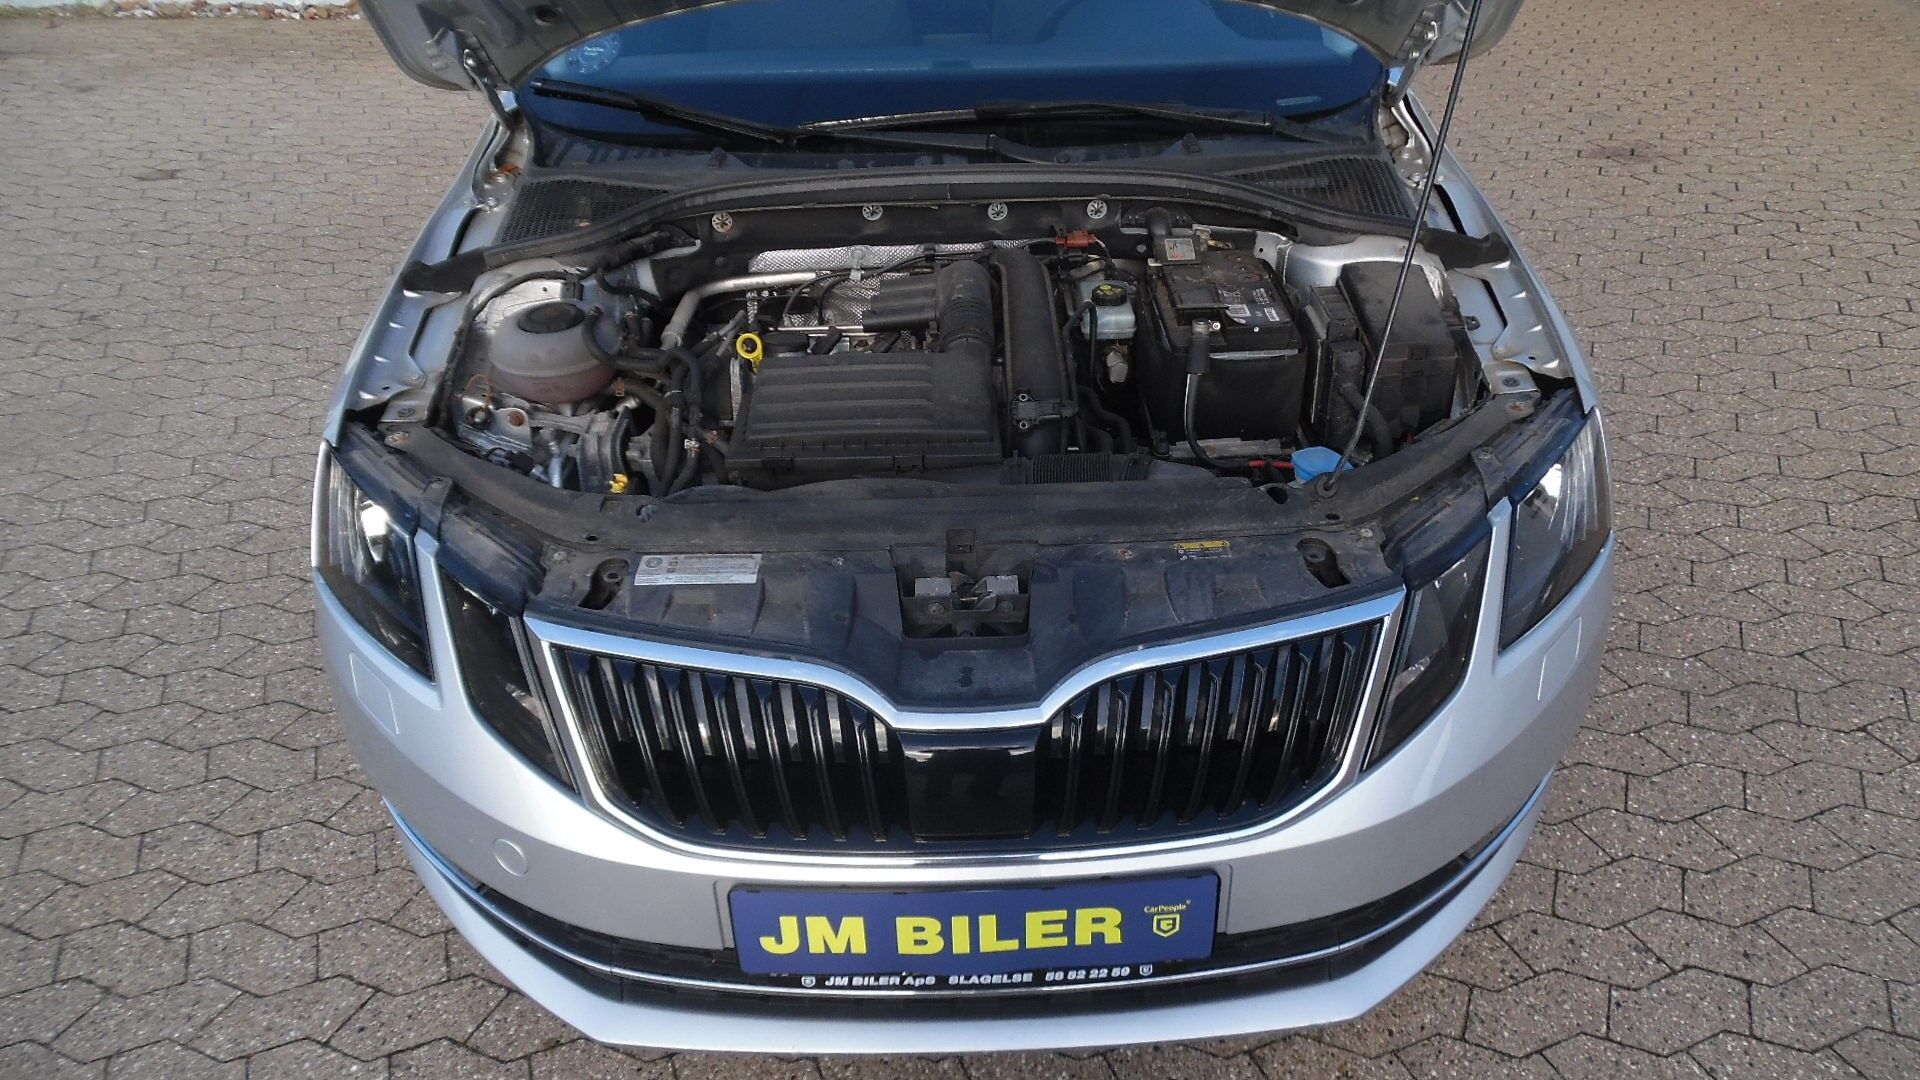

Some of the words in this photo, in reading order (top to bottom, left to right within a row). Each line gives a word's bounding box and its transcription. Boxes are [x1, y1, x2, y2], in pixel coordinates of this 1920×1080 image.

[759, 915, 867, 954] JM
[895, 907, 1122, 954] BILER
[825, 975, 849, 986] JM
[852, 975, 901, 986] BILER
[902, 975, 936, 987] ApS
[948, 973, 1033, 985] SLAGELSE
[1088, 969, 1107, 979] 22
